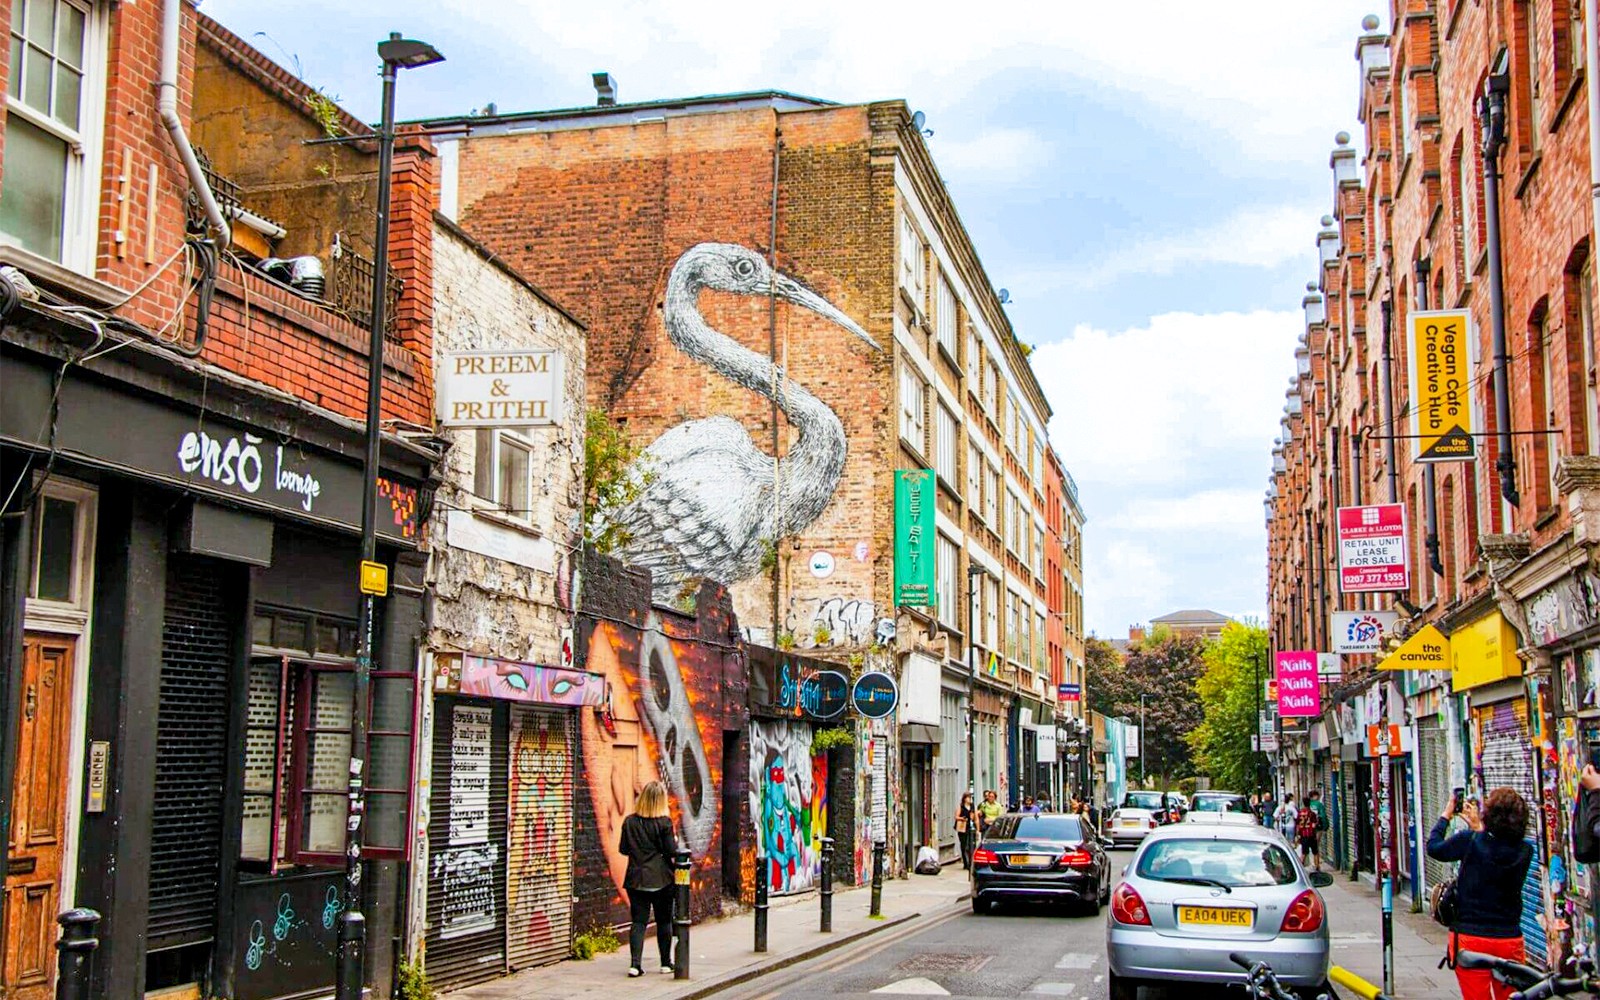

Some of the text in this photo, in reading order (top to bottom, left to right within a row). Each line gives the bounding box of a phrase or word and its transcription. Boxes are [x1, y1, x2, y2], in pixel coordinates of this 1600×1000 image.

[454, 355, 550, 375] PREEM
[1441, 324, 1462, 416] Vegan Cafe
[1426, 325, 1442, 429] Creative Hub
[490, 378, 511, 396] &
[452, 400, 548, 419] PRITHI
[1451, 438, 1467, 446] the
[276, 445, 320, 511] lounge
[1376, 524, 1402, 532] LLOYDS
[1345, 538, 1400, 548] RETAIL UNIT
[1357, 547, 1388, 556] LEASE
[1349, 556, 1397, 566] FOR SALE
[1344, 573, 1403, 583] 0207 377 1555
[1423, 643, 1441, 653] the
[1280, 659, 1312, 672] Nails
[1281, 677, 1313, 690] Nails
[1282, 694, 1314, 708] Nails
[1185, 909, 1247, 923] EA04 UEK
